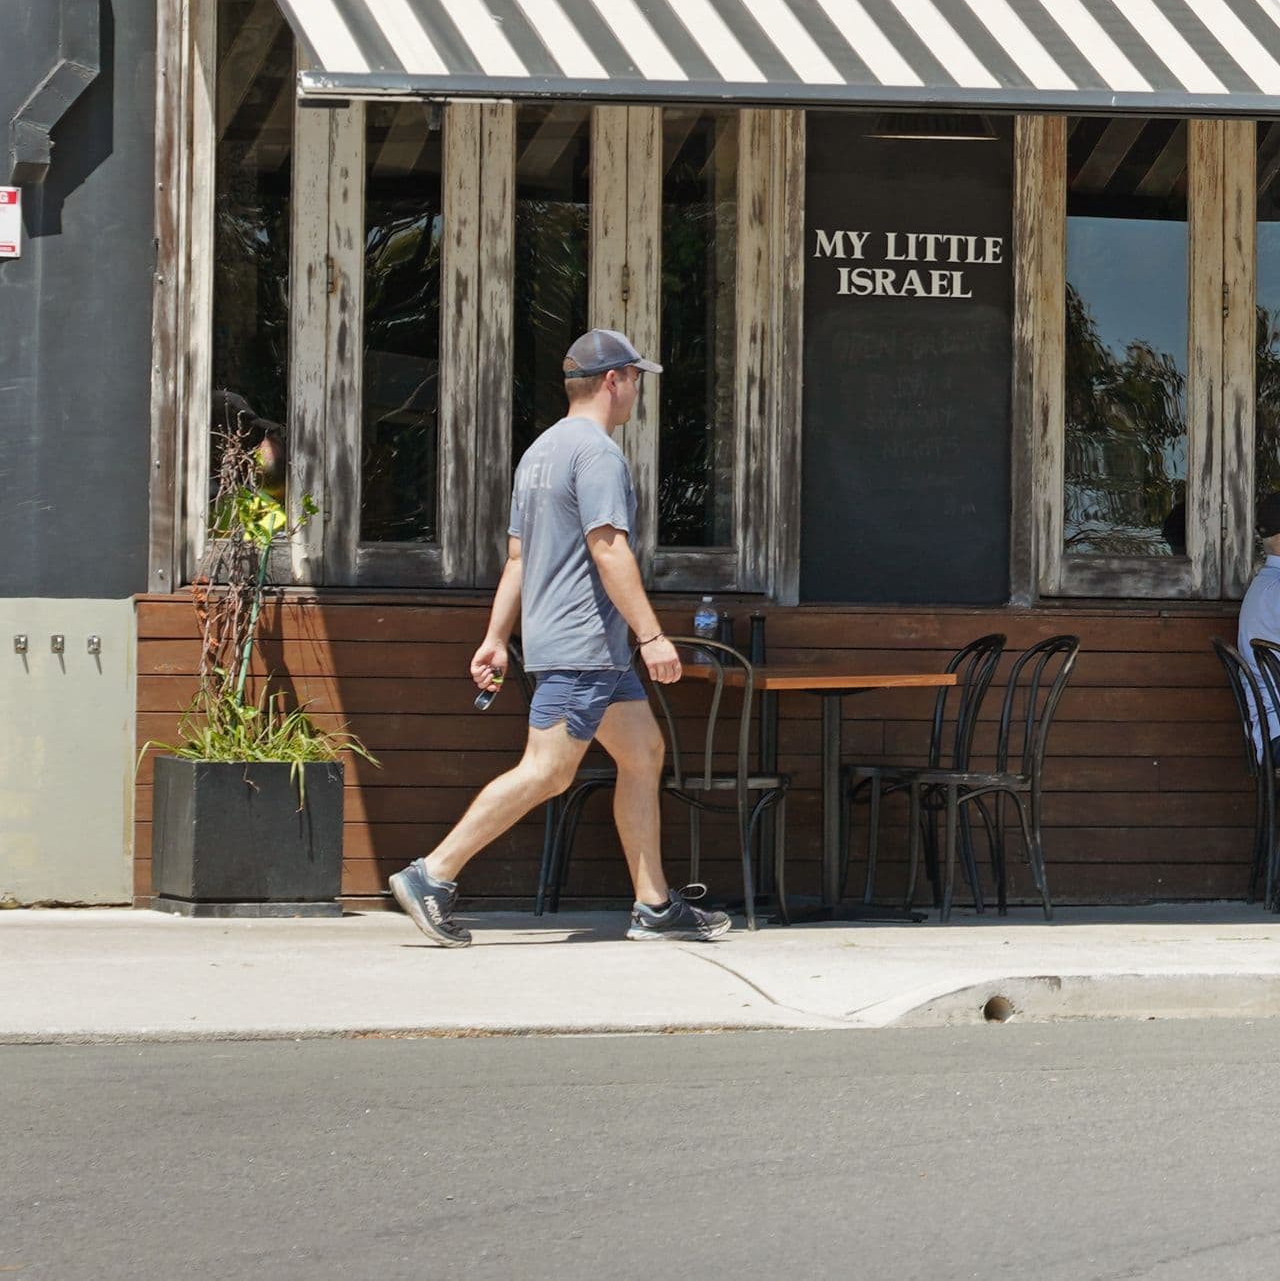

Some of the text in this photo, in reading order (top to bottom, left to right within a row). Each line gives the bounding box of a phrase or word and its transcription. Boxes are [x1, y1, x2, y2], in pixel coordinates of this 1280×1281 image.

[813, 229, 1003, 264] MY LITTLE
[836, 267, 973, 298] ISRAEL
